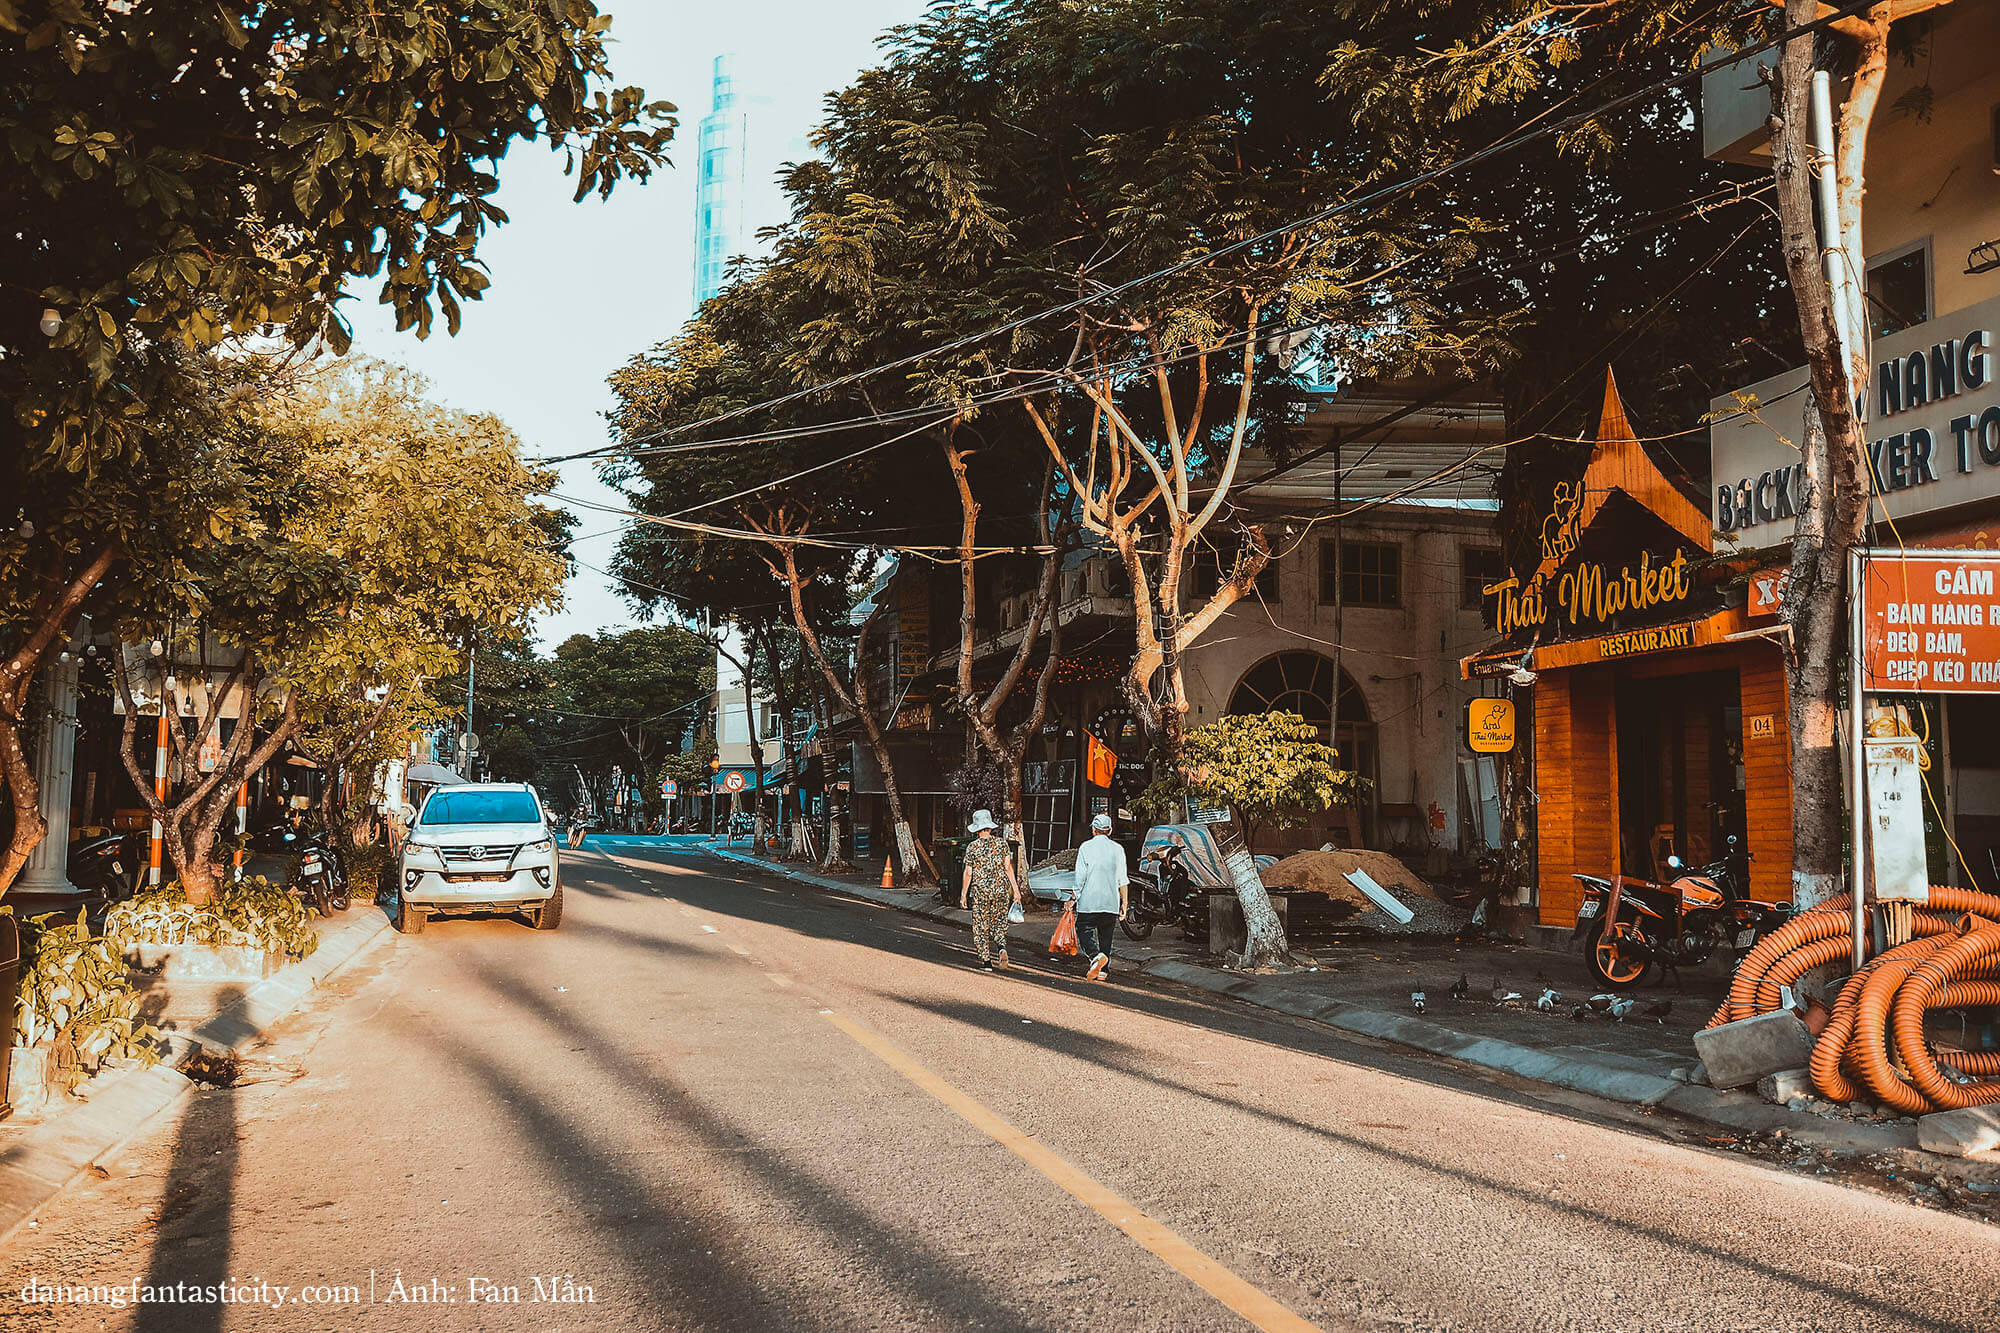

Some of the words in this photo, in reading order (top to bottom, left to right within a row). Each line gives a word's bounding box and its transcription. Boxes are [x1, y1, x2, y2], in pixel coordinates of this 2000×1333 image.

[1878, 329, 1992, 417] NANG
[1717, 427, 1939, 533] BACKKER
[1482, 573, 1548, 634] Thai
[1558, 548, 1690, 625] Market
[1935, 565, 1994, 595] CẤM
[1931, 600, 1983, 625] HÀNG
[1599, 627, 1689, 658] RESTAURANT
[1933, 658, 1965, 683] KÉO
[1754, 718, 1771, 732] 04
